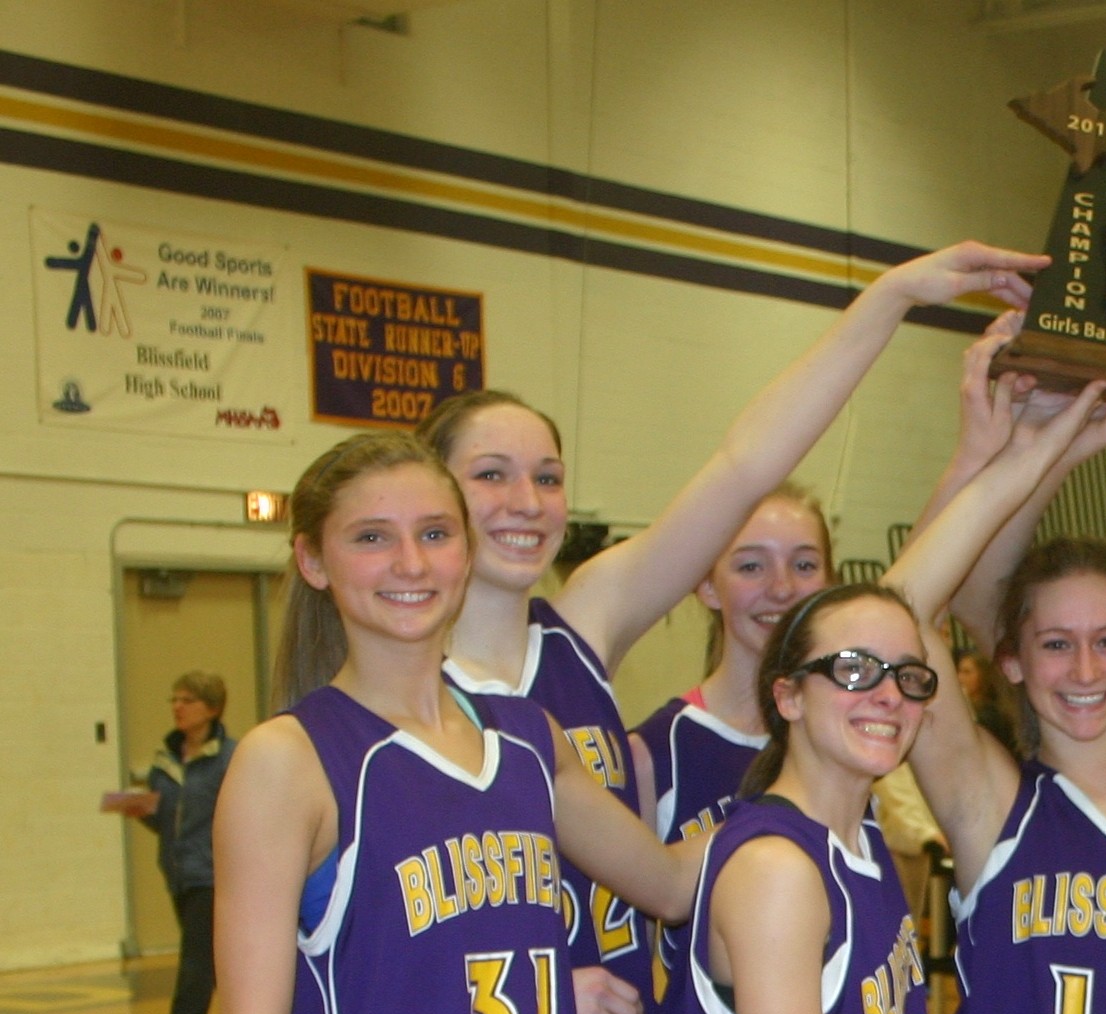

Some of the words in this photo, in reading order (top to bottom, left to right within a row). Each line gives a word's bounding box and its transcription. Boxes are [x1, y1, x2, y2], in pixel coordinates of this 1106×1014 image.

[158, 242, 209, 268] Good
[214, 250, 273, 277] Sports
[1064, 192, 1095, 311] CHAMPION
[157, 270, 189, 292] Are
[195, 276, 276, 303] Winners!
[201, 306, 231, 321] 2007
[332, 281, 461, 327] FOOTBALL
[168, 320, 222, 341] Football
[311, 312, 373, 348] STATE
[384, 323, 480, 360] RUNNER-UP
[1038, 313, 1080, 336] Girls
[136, 344, 210, 371] Blissfield
[332, 348, 440, 388] DIVISION
[125, 373, 164, 399] High
[169, 378, 222, 402] School
[372, 388, 435, 421] 2007
